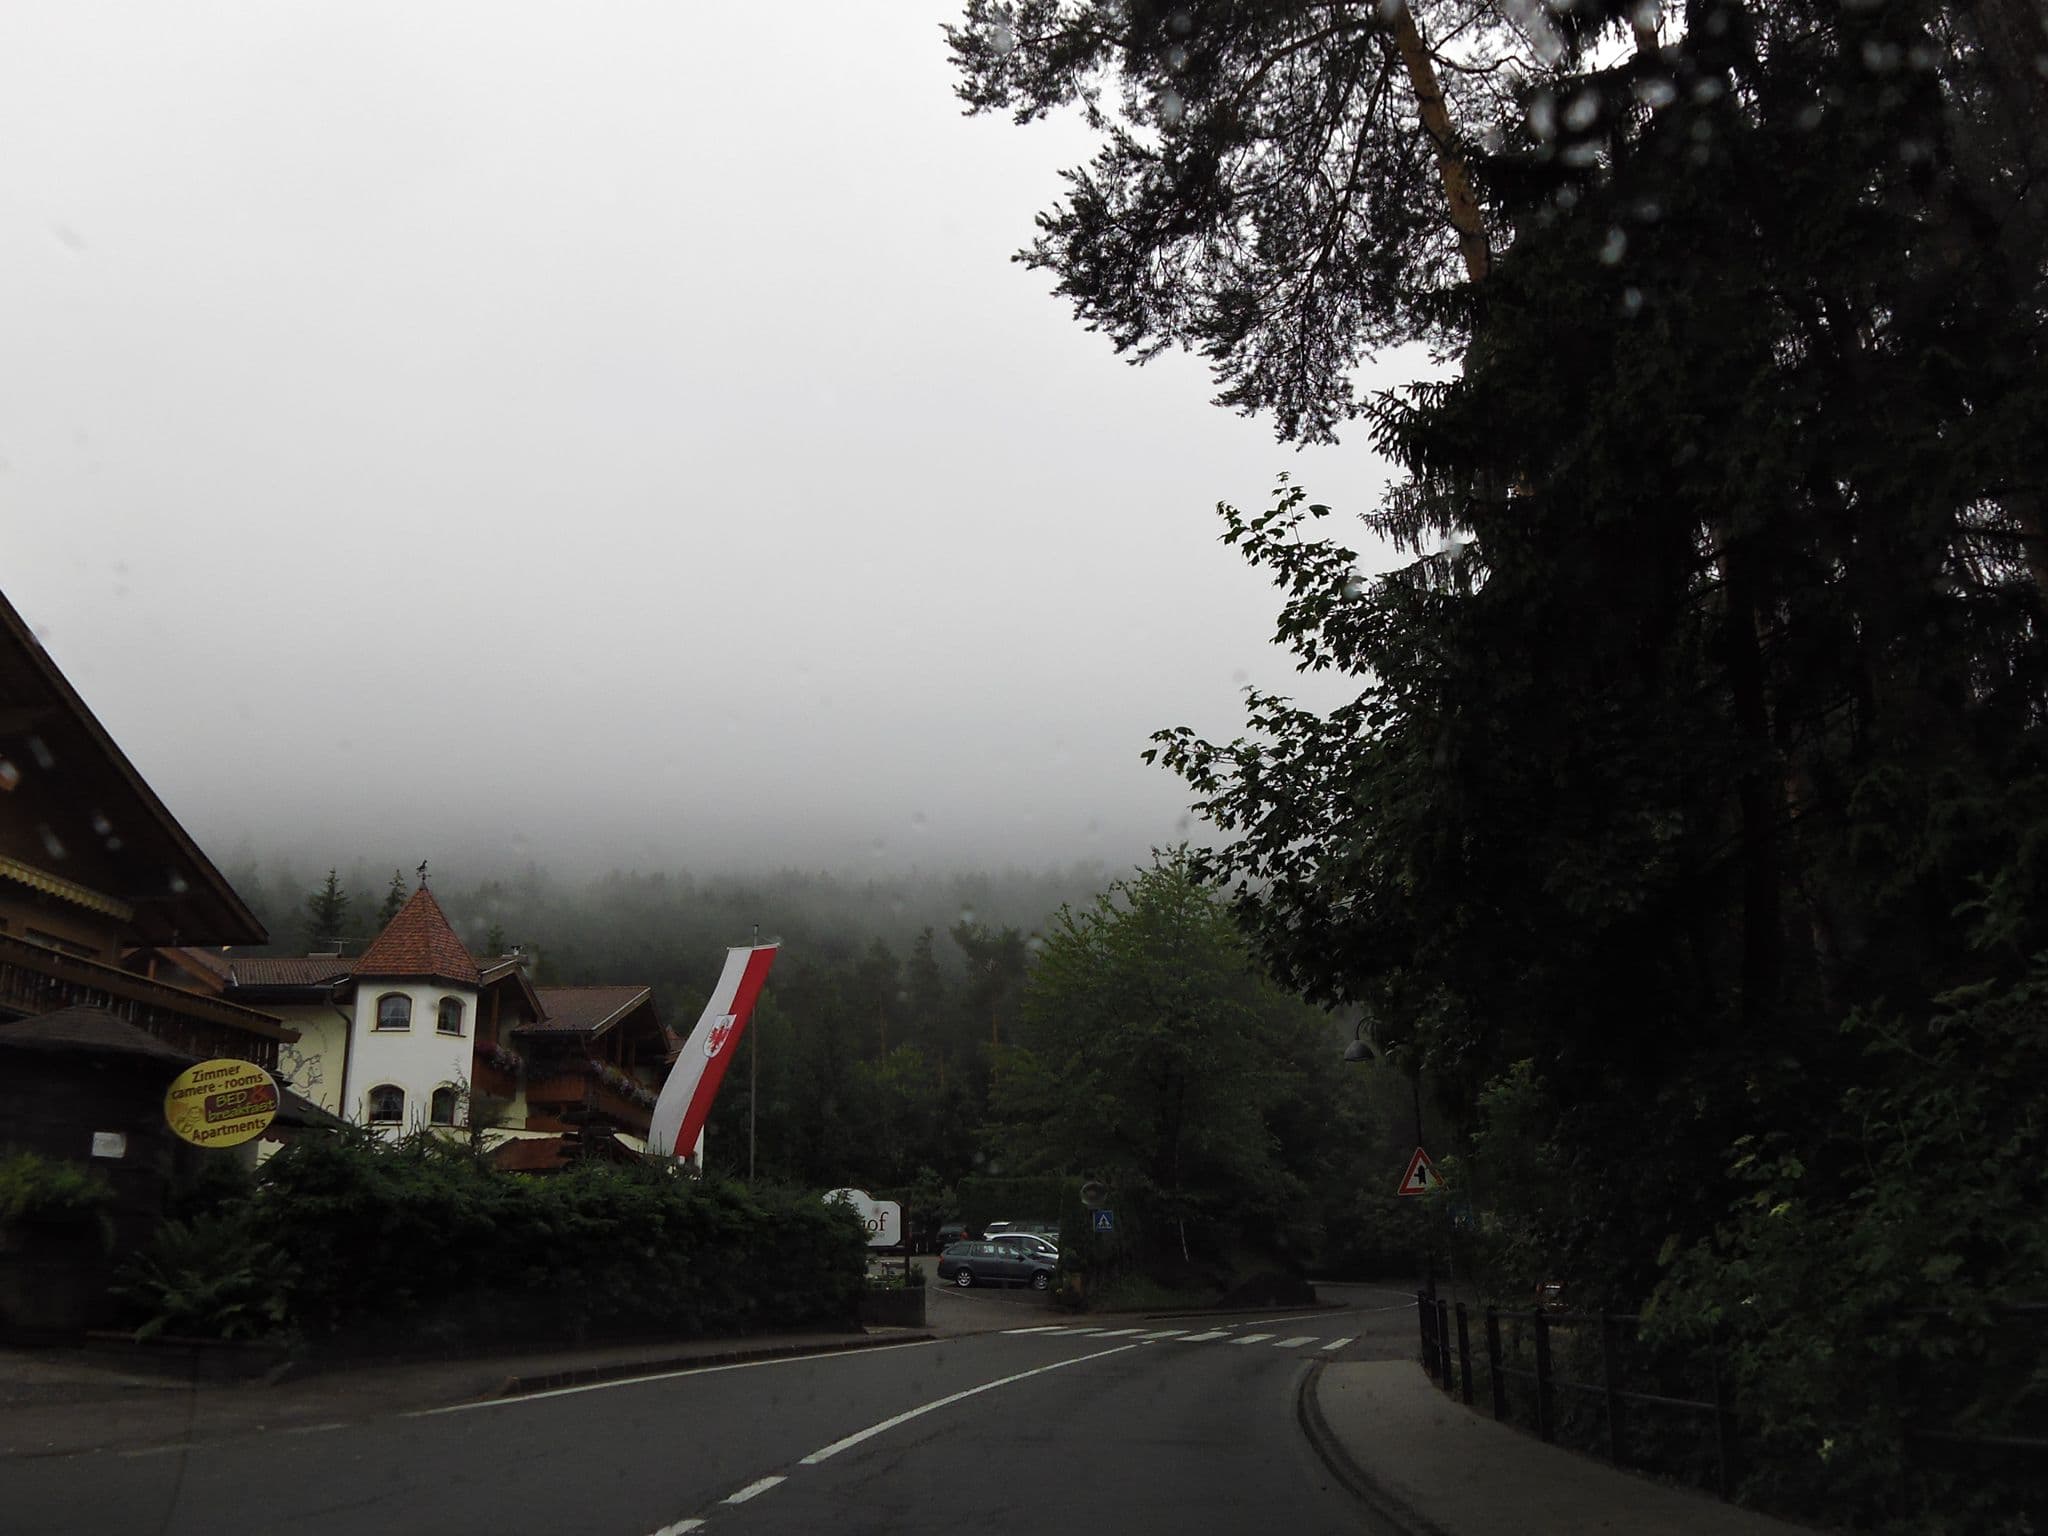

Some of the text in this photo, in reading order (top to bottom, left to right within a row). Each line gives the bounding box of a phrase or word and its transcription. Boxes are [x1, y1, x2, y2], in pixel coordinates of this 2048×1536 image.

[192, 1065, 240, 1083] Zimmer
[172, 1083, 216, 1099] camere
[225, 1073, 263, 1089] rooms
[216, 1091, 247, 1108] BED
[207, 1100, 276, 1122] breakfast
[192, 1118, 266, 1142] Apartments
